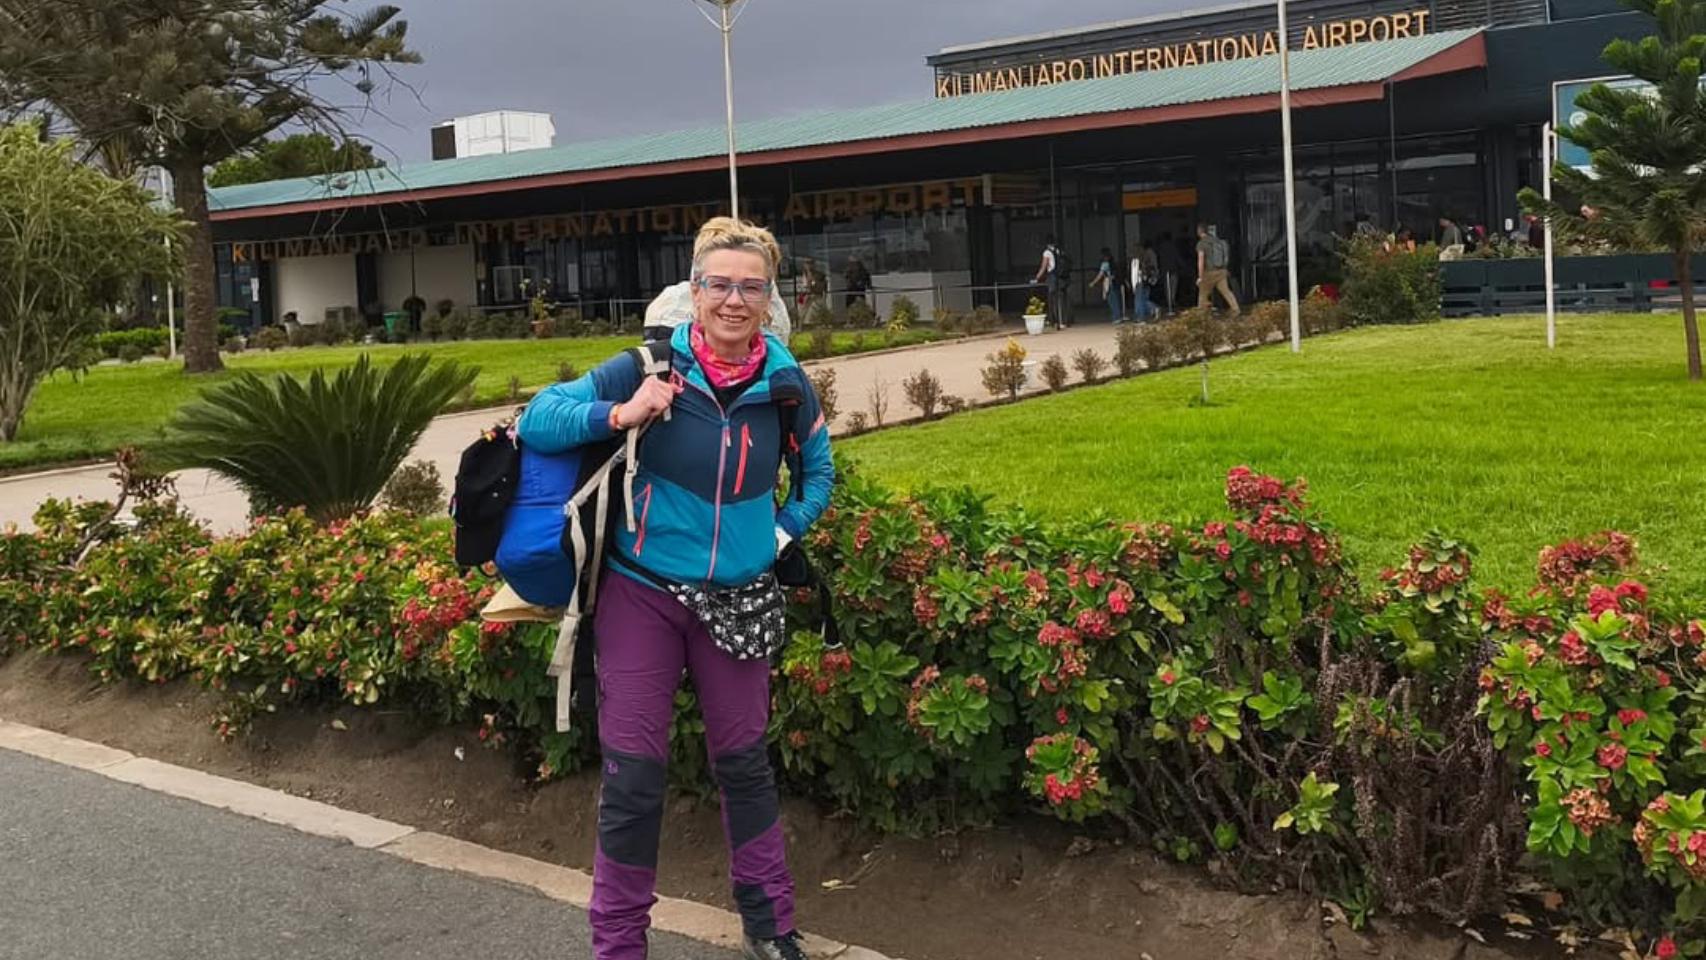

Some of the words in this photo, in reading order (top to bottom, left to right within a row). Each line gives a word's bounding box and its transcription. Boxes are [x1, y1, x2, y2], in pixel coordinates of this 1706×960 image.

[1092, 31, 1282, 80] INTERNATIONA
[1302, 10, 1430, 50] AIRPORT
[231, 231, 427, 264] KILIMANJARO
[783, 179, 982, 221] AIRPORT
